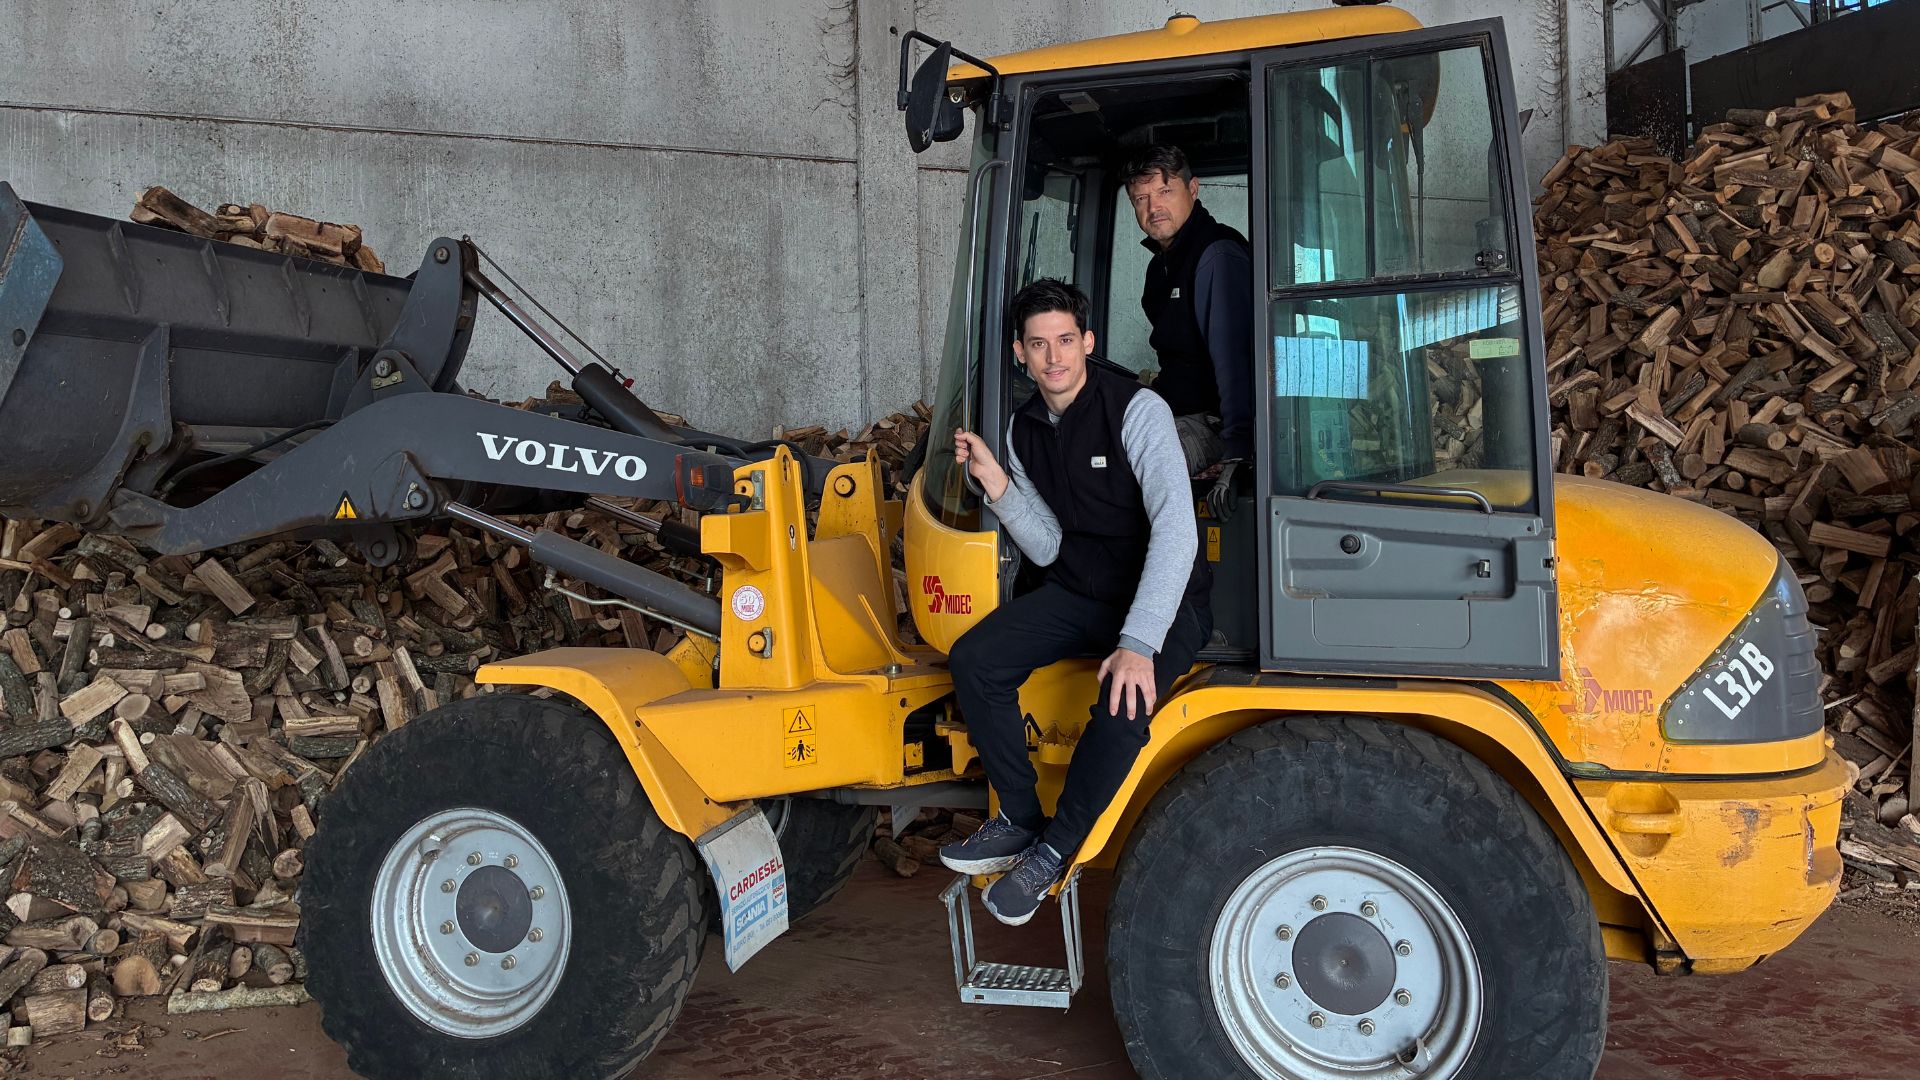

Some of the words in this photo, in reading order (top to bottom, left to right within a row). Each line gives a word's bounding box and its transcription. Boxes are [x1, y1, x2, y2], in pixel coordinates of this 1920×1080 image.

[476, 431, 648, 482] VOLVO
[945, 594, 972, 615] MIDEC
[1702, 642, 1775, 720] L32B
[1603, 689, 1654, 713] MIDEC
[730, 856, 783, 901] CARDIESEL
[736, 900, 767, 932] SCANIA
